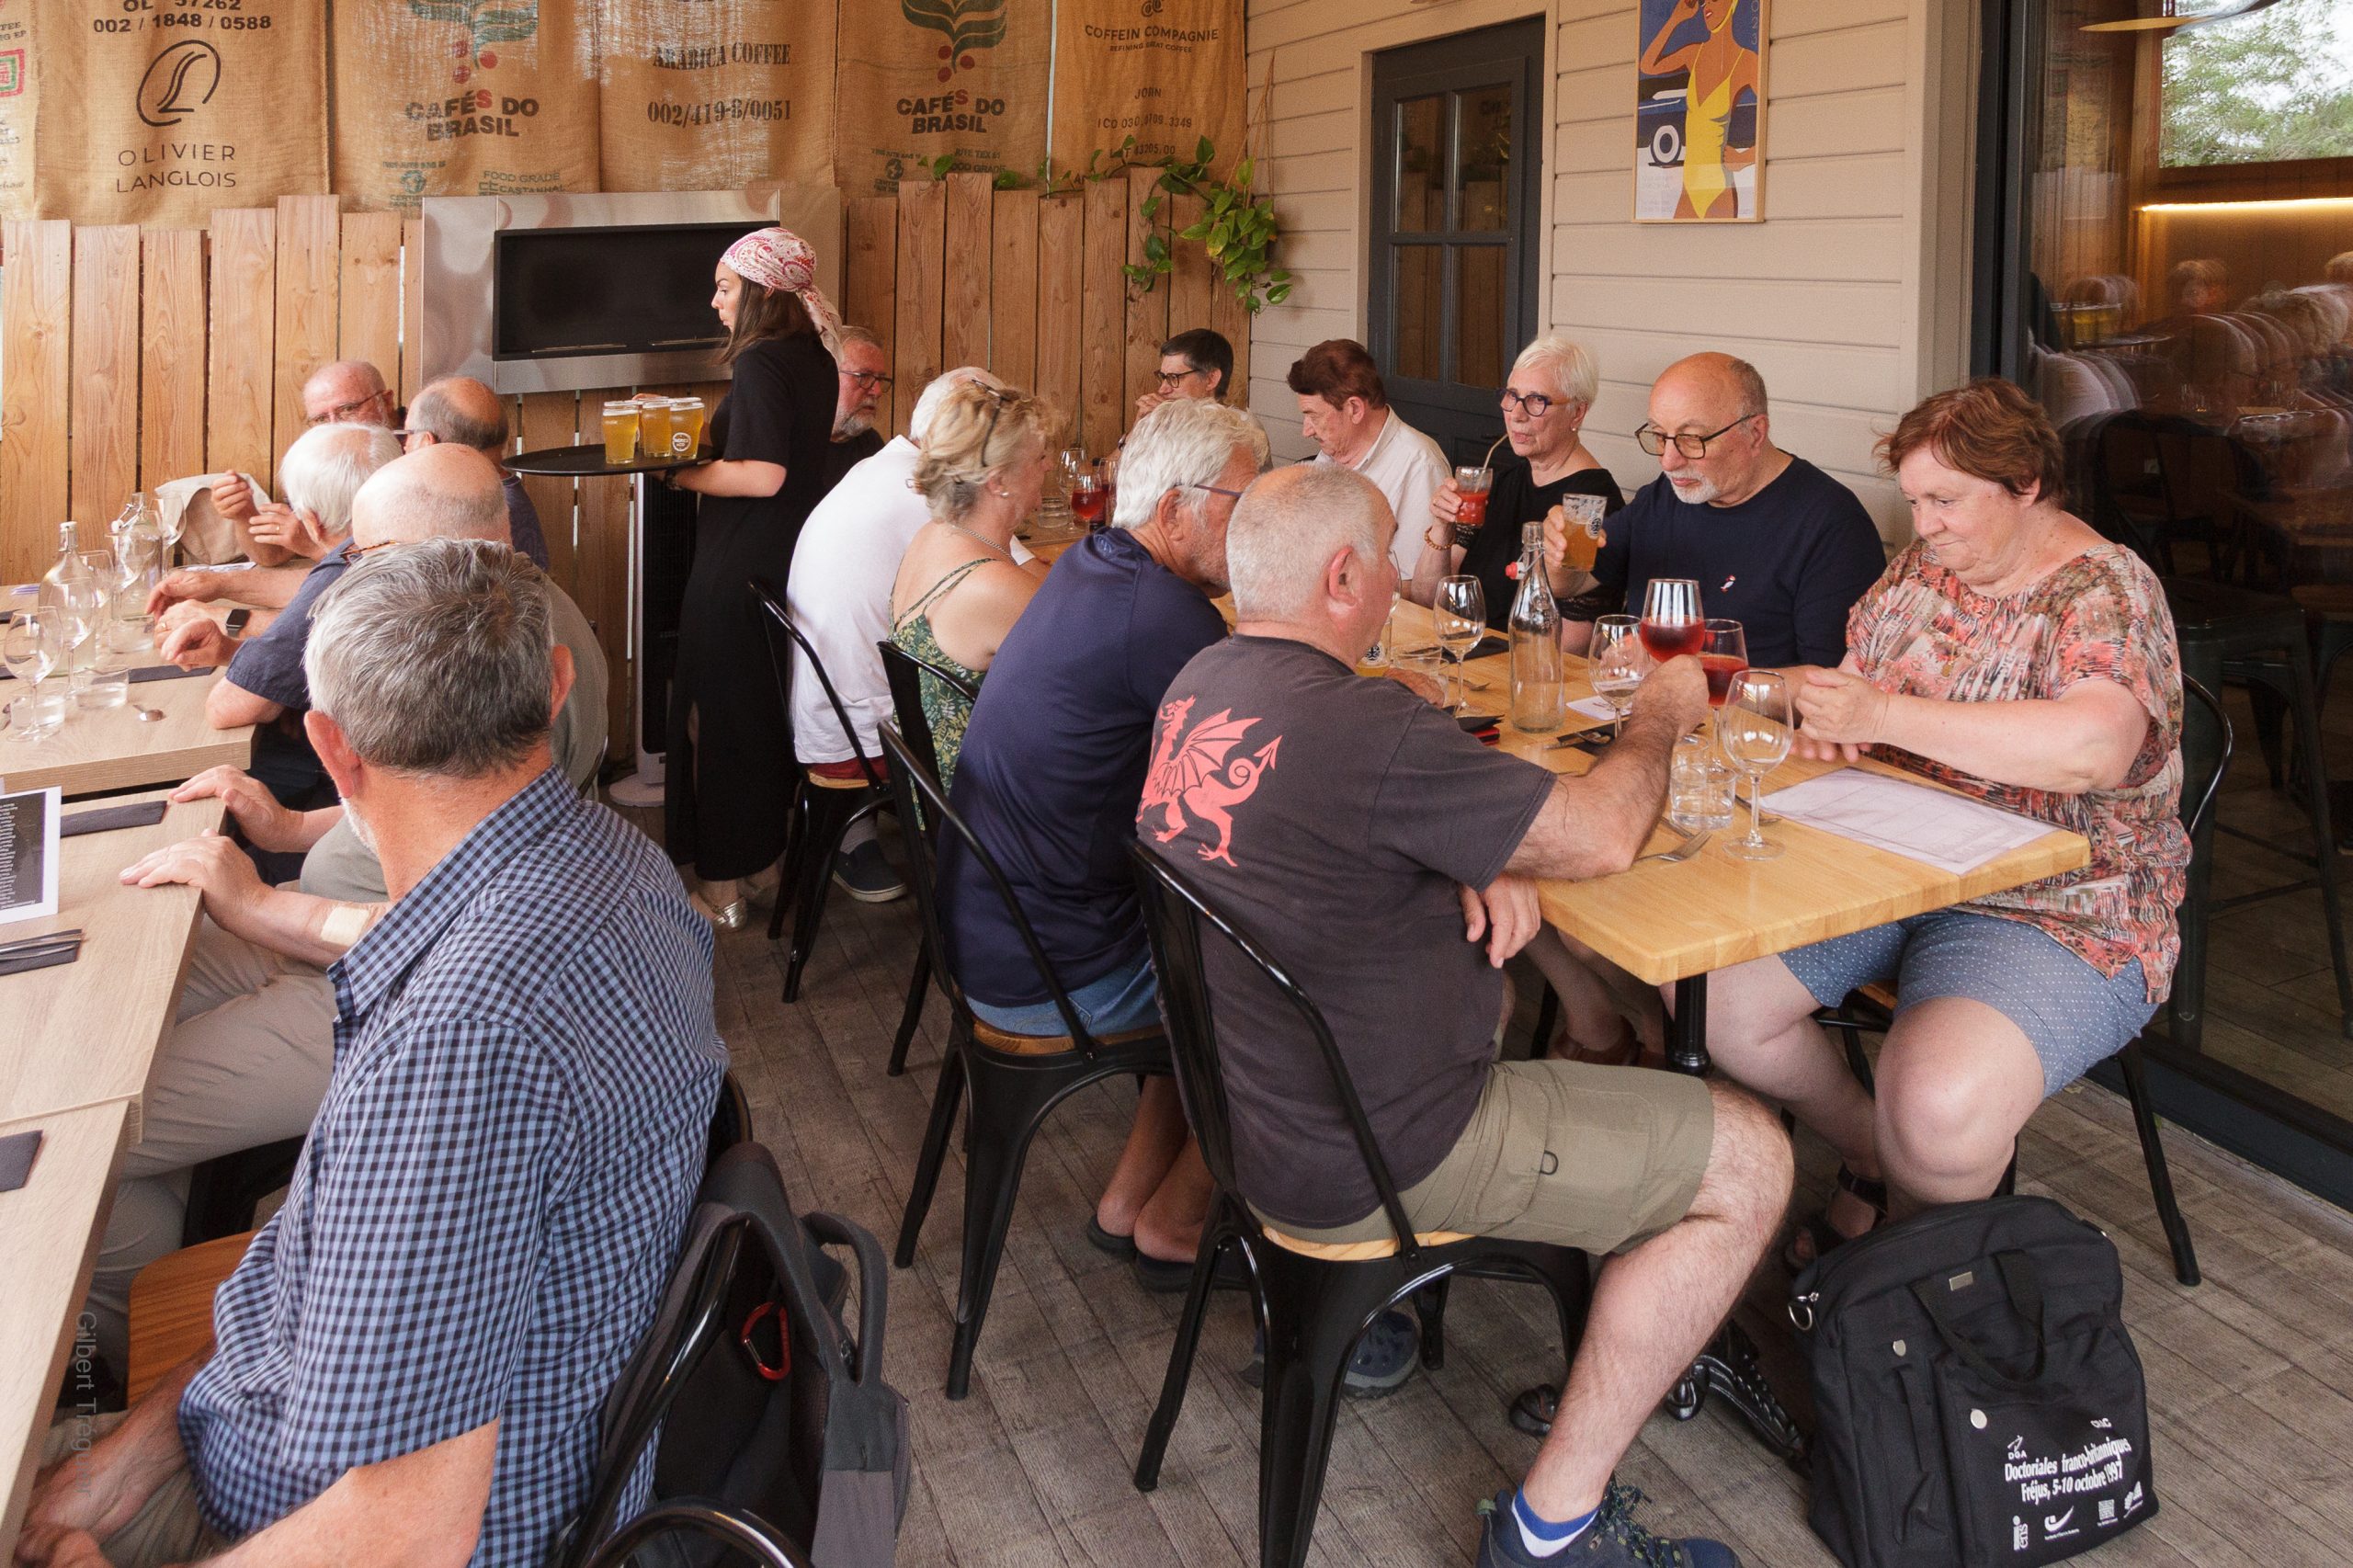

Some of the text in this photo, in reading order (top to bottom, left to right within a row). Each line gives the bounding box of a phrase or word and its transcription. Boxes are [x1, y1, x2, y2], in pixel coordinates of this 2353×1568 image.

[94, 18, 131, 32] 002
[153, 13, 201, 28] 1848
[220, 16, 271, 29] 0588
[1085, 25, 1219, 42] COFFEIN COMPAGNIE
[653, 42, 790, 70] ARABICA COFFEE
[1109, 42, 1143, 52] REFINING
[1165, 44, 1192, 53] COFFEE
[405, 89, 540, 120] CAFÉS DO
[897, 89, 1006, 116] CAFÉS DO
[426, 115, 519, 142] BRASIL
[912, 113, 987, 134] BRASIL
[119, 143, 235, 166] OLIVIER
[1109, 147, 1131, 158] LT
[117, 170, 236, 192] LANGLOIS
[483, 170, 560, 183] FOOD GRADE
[2005, 1436, 2132, 1482] Doctoriales franco-britanniques
[2007, 1449, 2028, 1460] DGA
[2021, 1461, 2123, 1506] Fréjus, 5-10 octobre 1997
